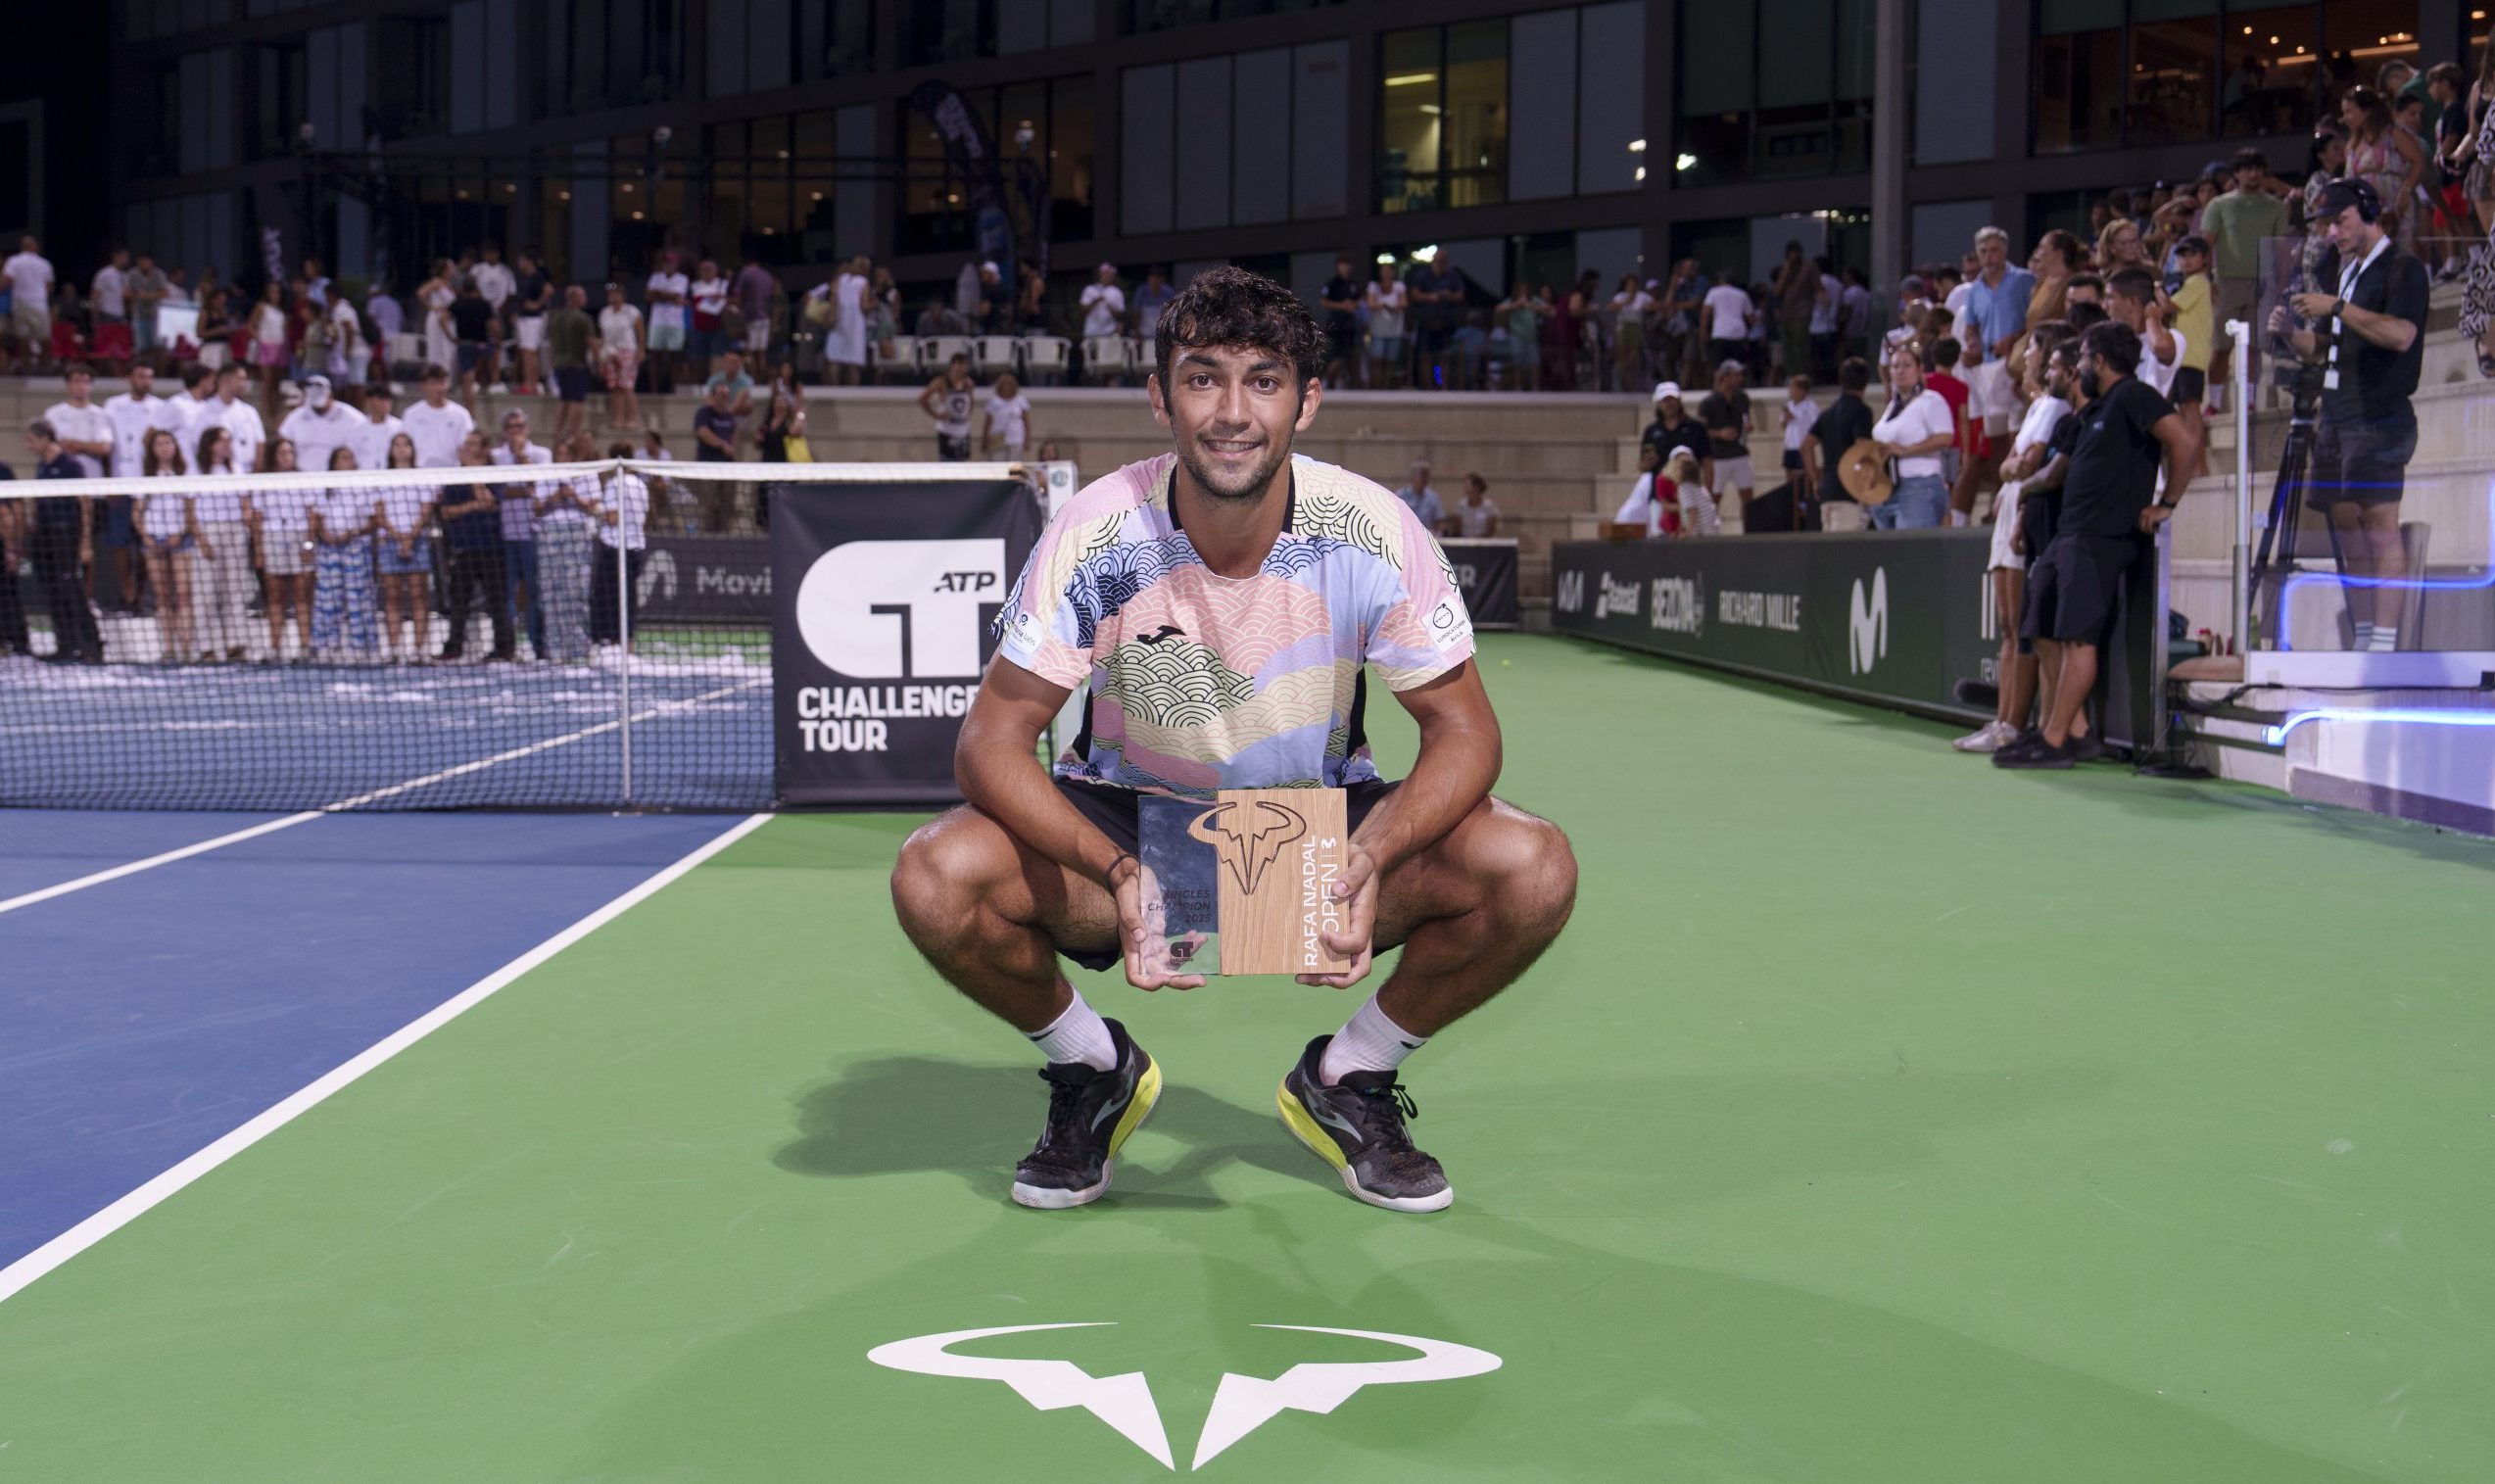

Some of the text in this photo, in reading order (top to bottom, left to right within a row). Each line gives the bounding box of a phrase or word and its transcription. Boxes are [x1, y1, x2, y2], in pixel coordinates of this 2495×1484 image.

[933, 571, 997, 593] ATP
[1719, 591, 1801, 632] RICHARD MILLE
[797, 685, 981, 719] CHALLENG
[798, 720, 888, 753] TOUR
[1301, 835, 1319, 967] RAFA NADAL
